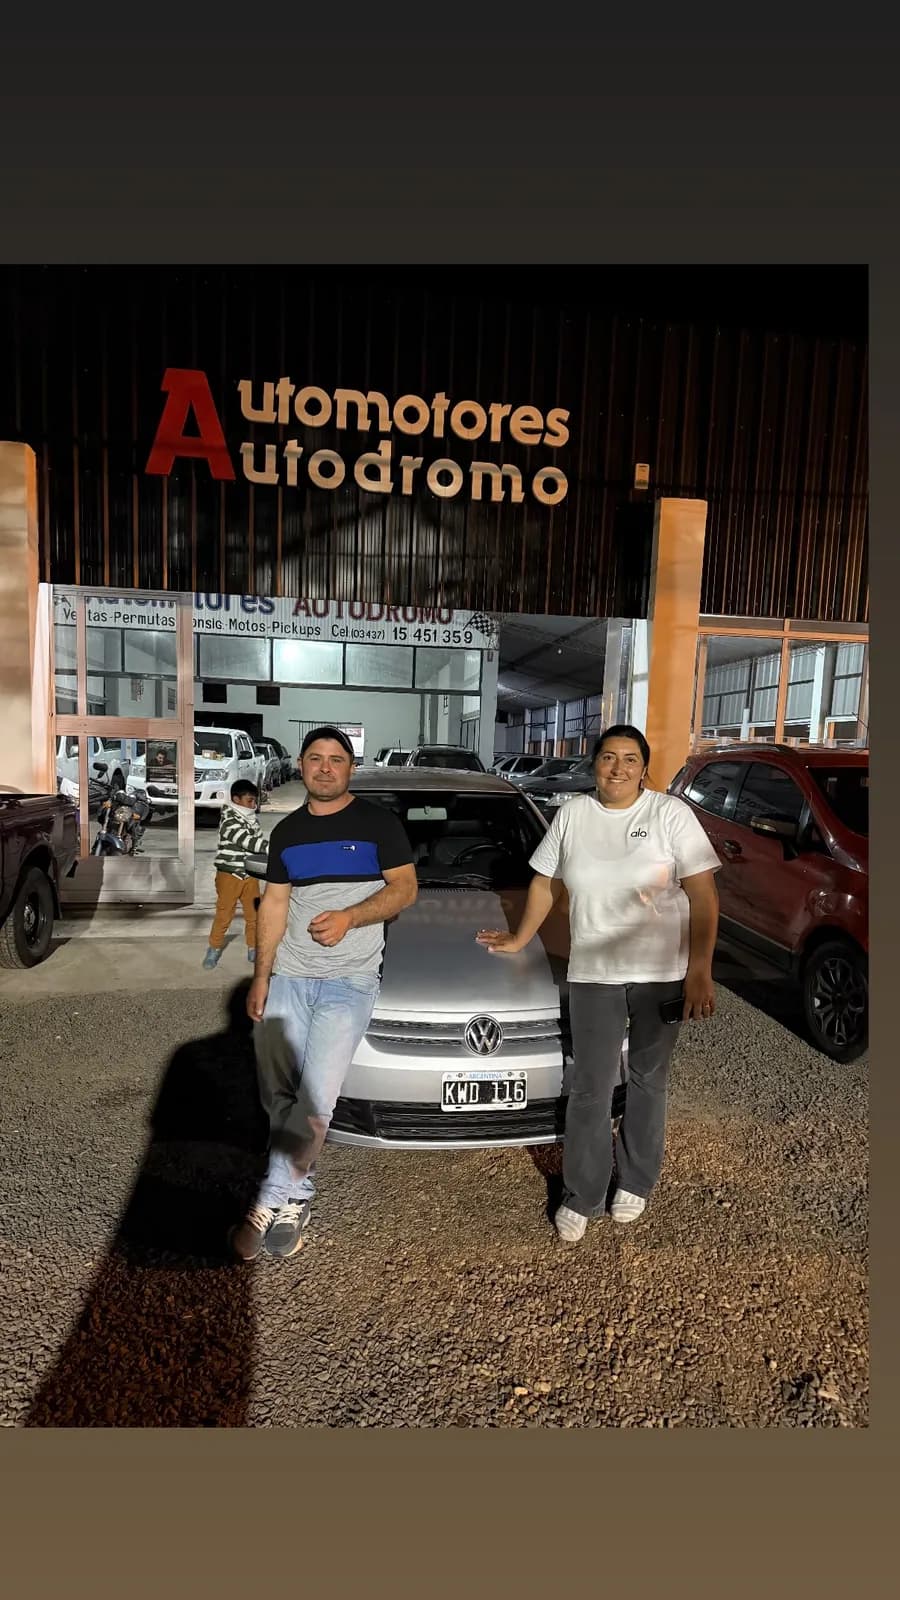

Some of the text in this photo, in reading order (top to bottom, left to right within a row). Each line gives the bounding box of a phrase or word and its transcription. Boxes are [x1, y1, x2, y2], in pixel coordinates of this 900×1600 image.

[392, 627, 407, 641] 15
[413, 628, 437, 642] 451
[442, 630, 473, 644] 359
[630, 827, 648, 838] alo
[445, 1081, 525, 1104] KWD 116
